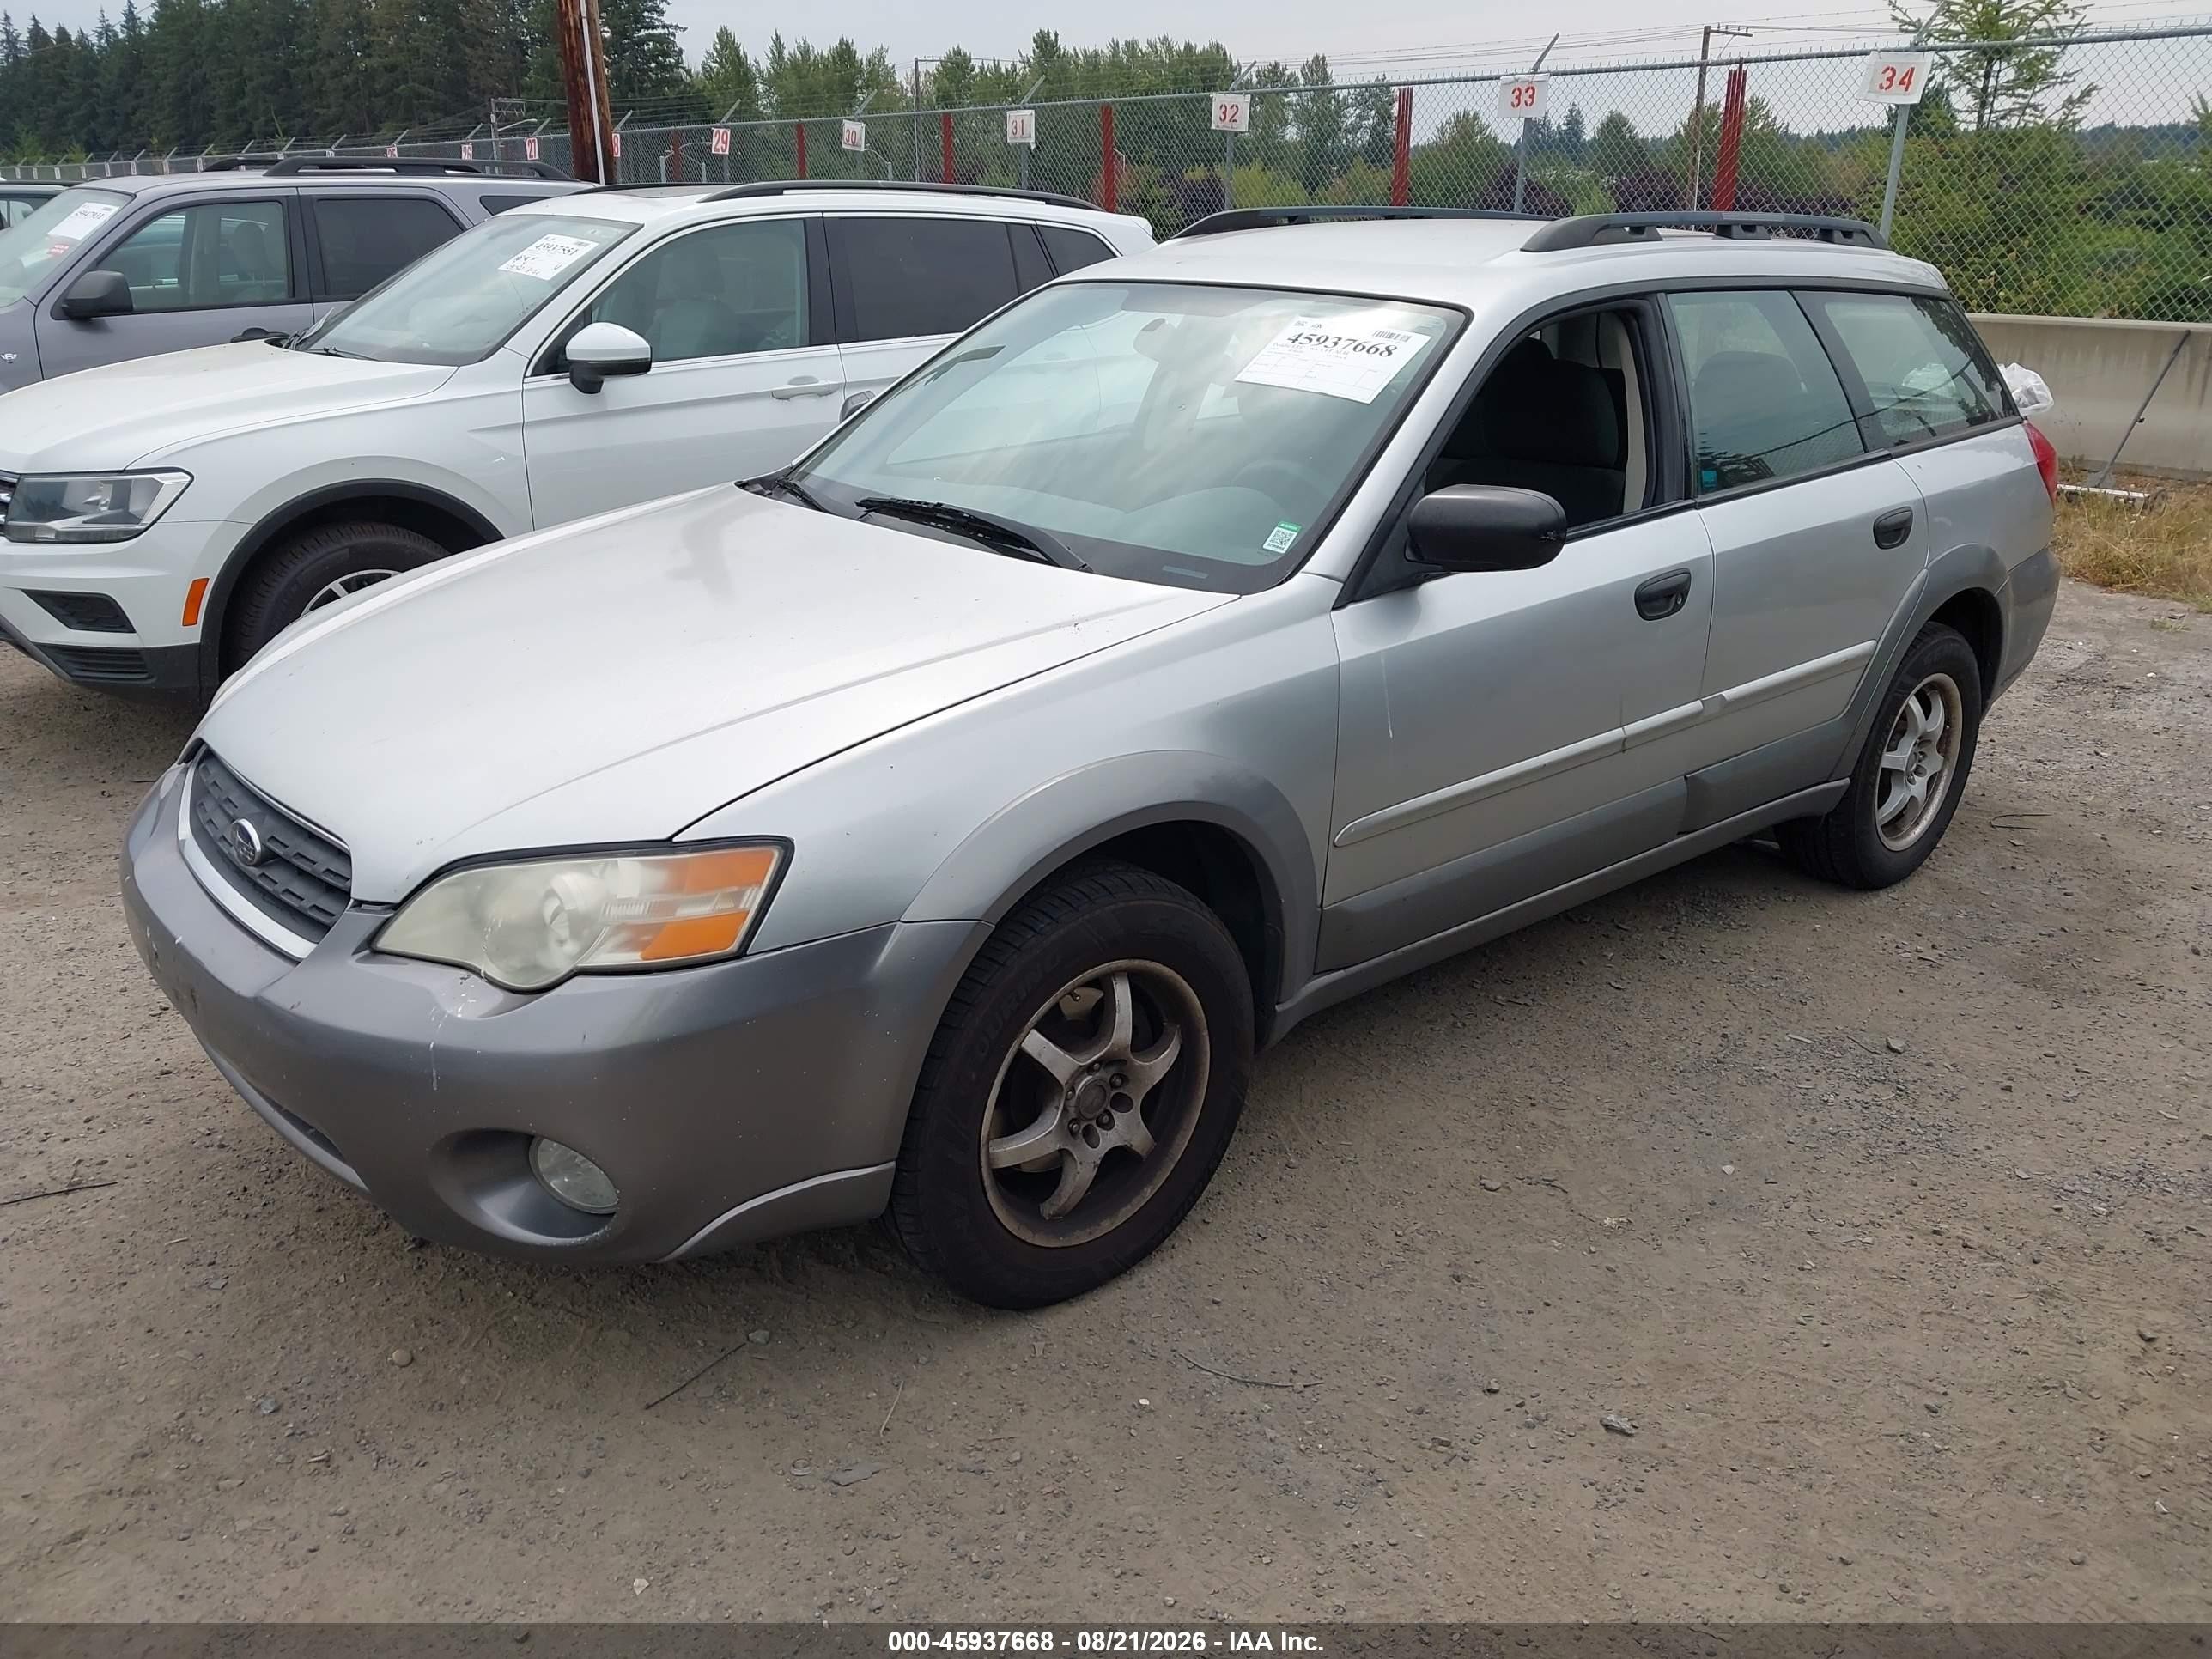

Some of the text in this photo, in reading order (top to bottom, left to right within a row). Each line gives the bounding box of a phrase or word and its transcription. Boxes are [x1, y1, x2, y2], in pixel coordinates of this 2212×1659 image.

[1878, 65, 1916, 92] 34
[1510, 86, 1536, 108] 33
[1219, 103, 1239, 123] 32
[845, 129, 857, 145] 30
[1012, 118, 1024, 136] 31
[527, 138, 537, 159] 27
[612, 134, 619, 156] 8
[713, 129, 729, 153] 29
[463, 146, 471, 160] 26
[1287, 331, 1399, 357] 45937668
